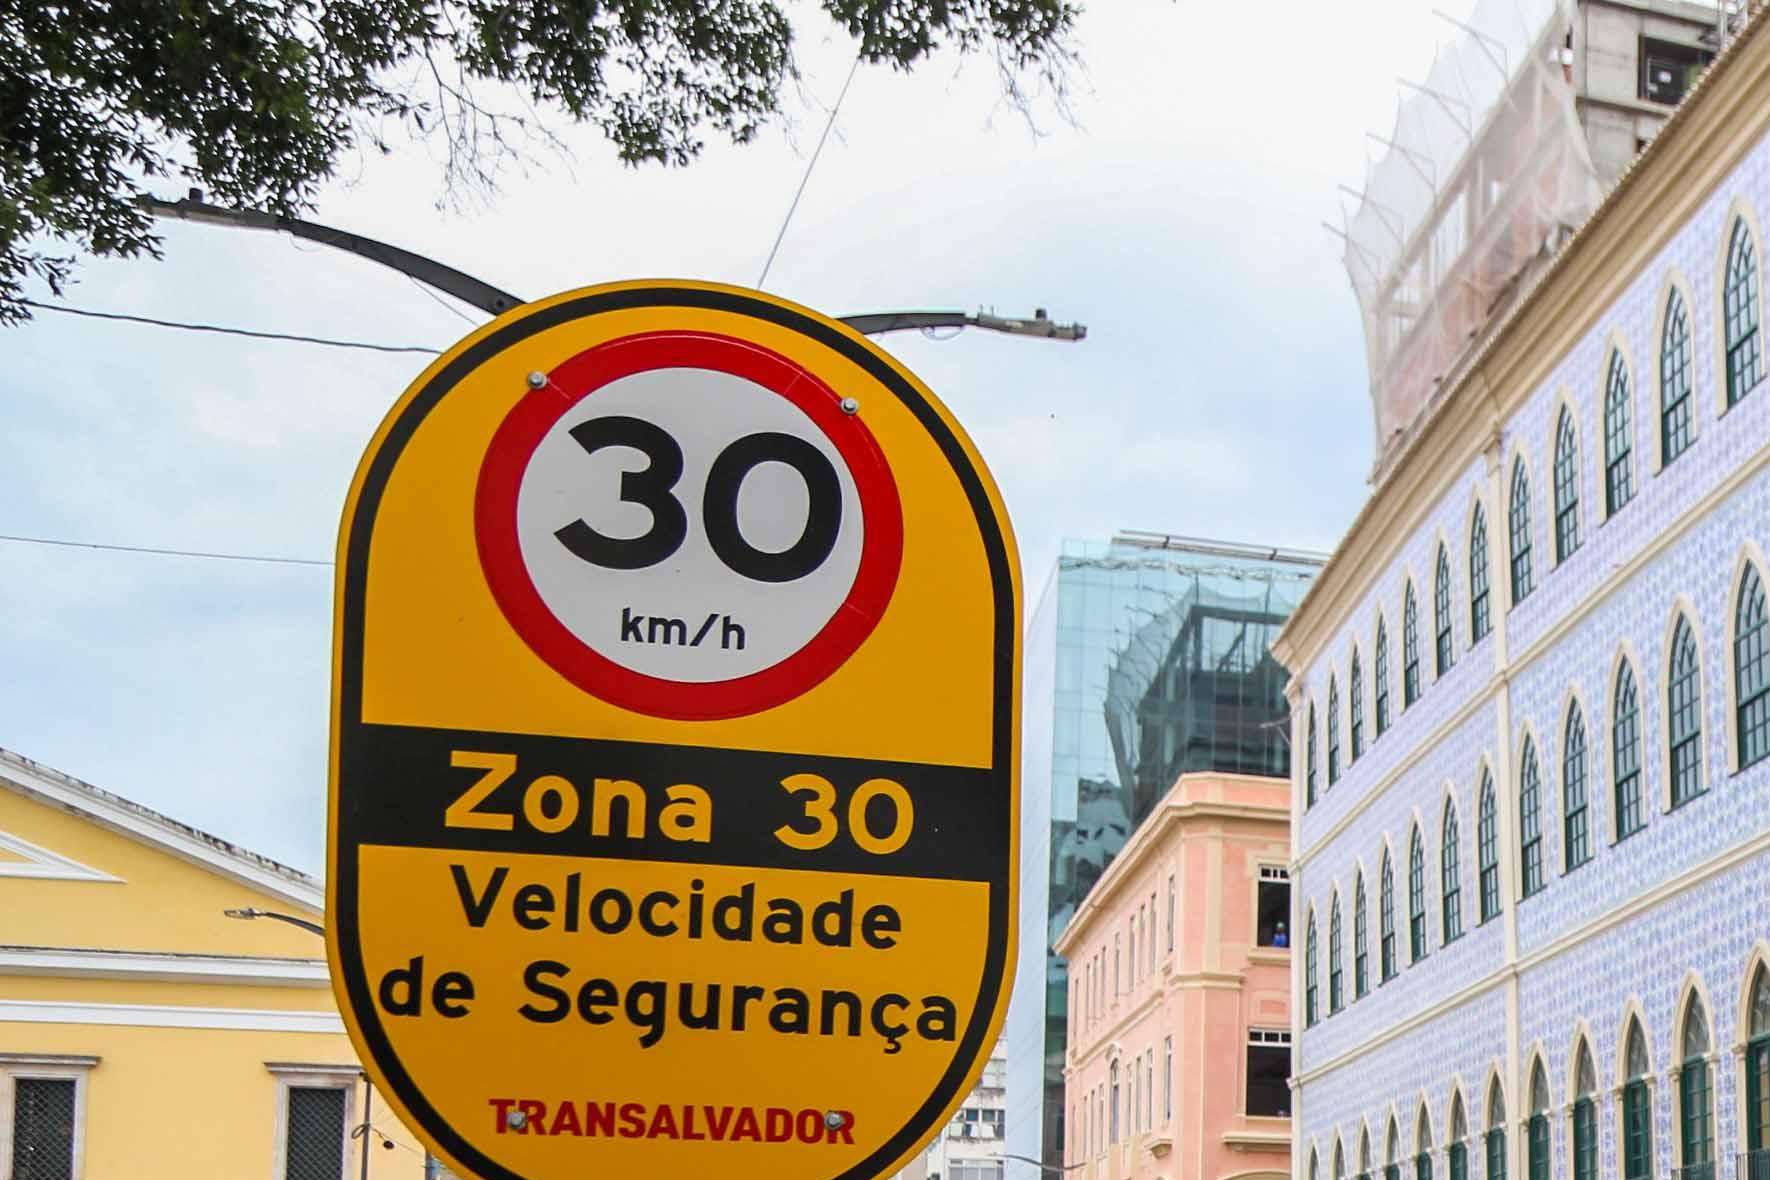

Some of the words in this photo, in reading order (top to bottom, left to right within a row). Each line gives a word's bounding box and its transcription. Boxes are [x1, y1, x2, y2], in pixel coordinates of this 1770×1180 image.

[553, 416, 842, 583] 30
[619, 606, 745, 651] km/h
[444, 750, 712, 842] Zona
[774, 773, 914, 855] 30
[450, 864, 901, 949] Velocidade
[378, 956, 475, 1018] de
[518, 960, 957, 1055] Segurança
[489, 1098, 855, 1145] TRANSALVADOR
